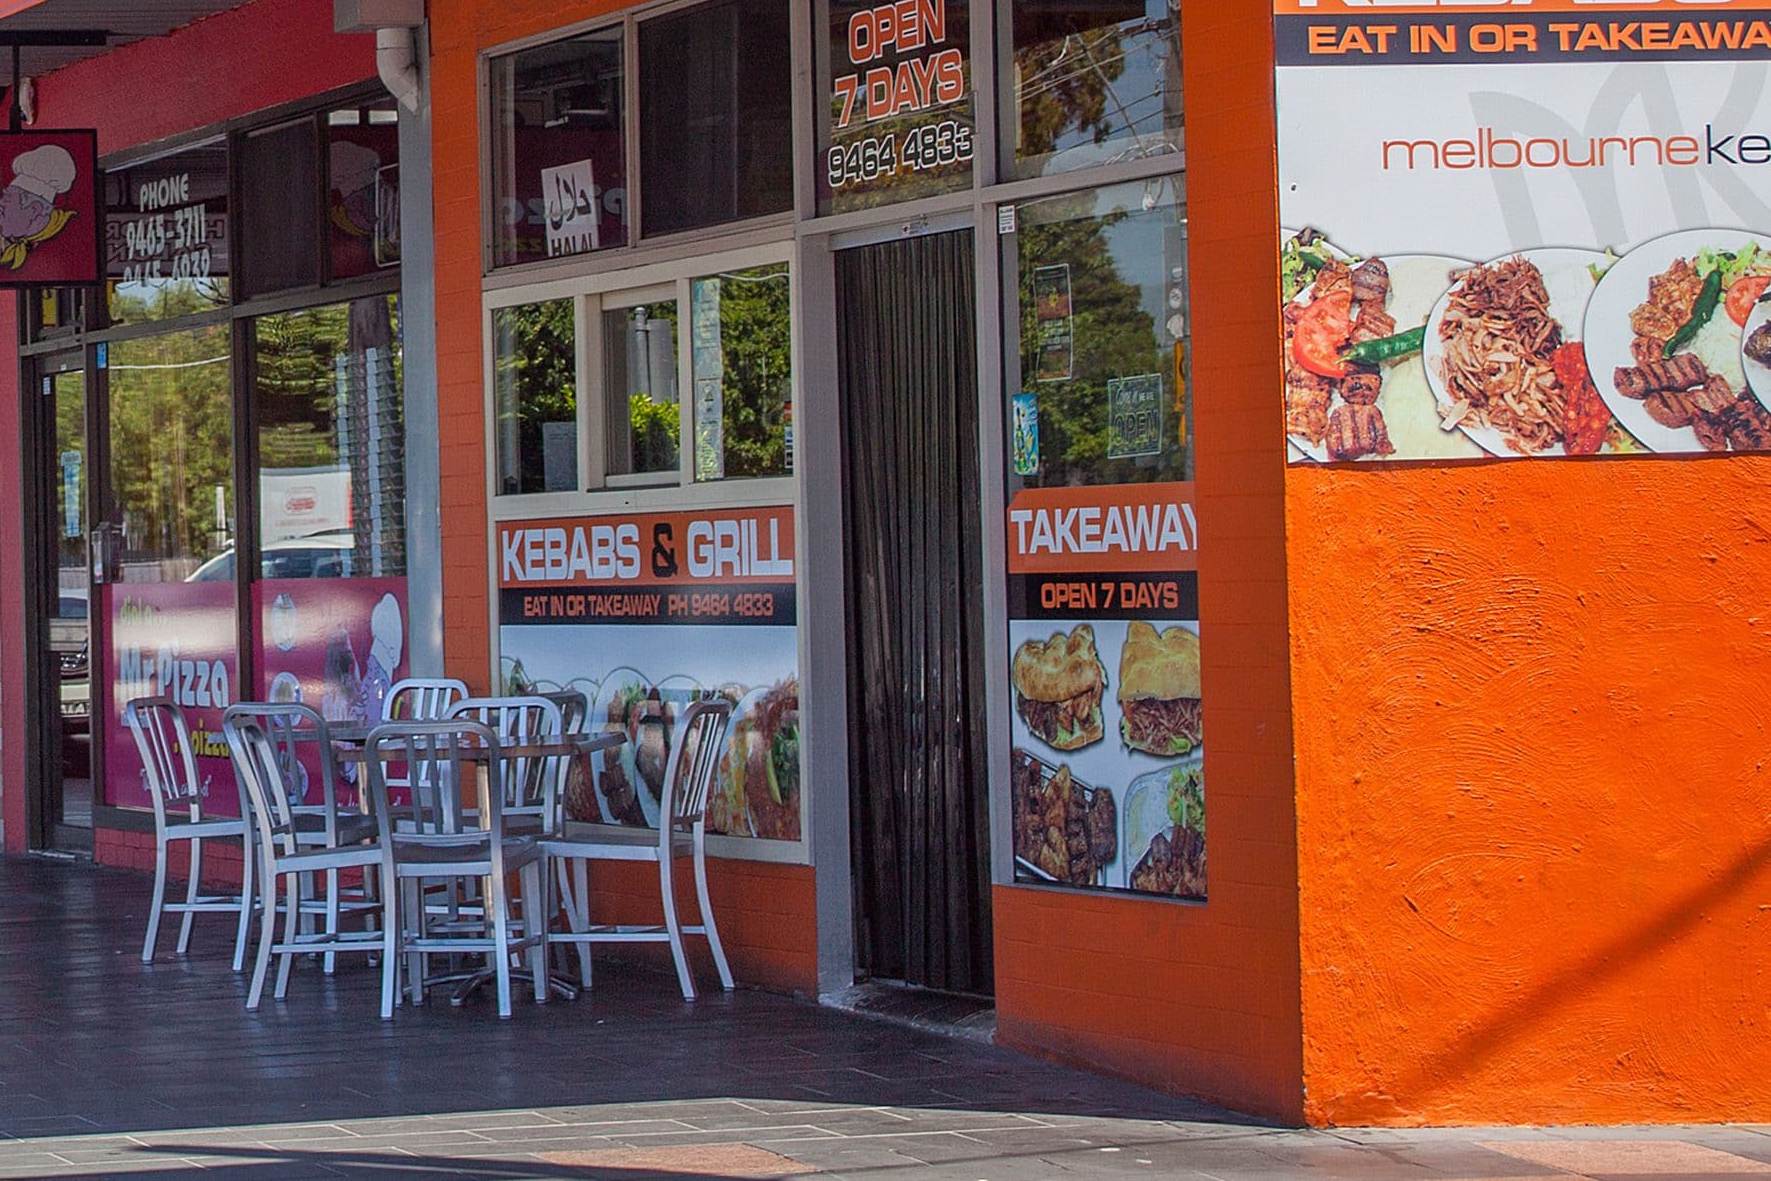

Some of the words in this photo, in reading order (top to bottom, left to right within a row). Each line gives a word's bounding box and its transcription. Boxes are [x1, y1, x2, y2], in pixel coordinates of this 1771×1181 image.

[1307, 24, 1397, 55] EAT
[1409, 23, 1457, 54] IN
[1470, 22, 1537, 53] OR
[1549, 20, 1771, 52] TAKEAWA
[834, 74, 859, 129] 7
[866, 48, 964, 122] DAYS
[828, 134, 897, 188] 9464
[902, 121, 975, 171] 4833
[140, 172, 189, 212] PHONE
[502, 523, 641, 582] KEBABS
[651, 522, 678, 578] &
[687, 518, 794, 577] GRILL
[524, 595, 549, 617] EAT
[551, 595, 564, 617] IN
[566, 595, 585, 616] OR
[588, 594, 661, 617] TAKEAWAY
[668, 594, 688, 617] PH
[692, 593, 729, 616] 9464
[733, 593, 774, 616] 4833
[1040, 583, 1097, 609] OPEN
[1100, 583, 1115, 608] 7
[1120, 582, 1179, 609] DAYS
